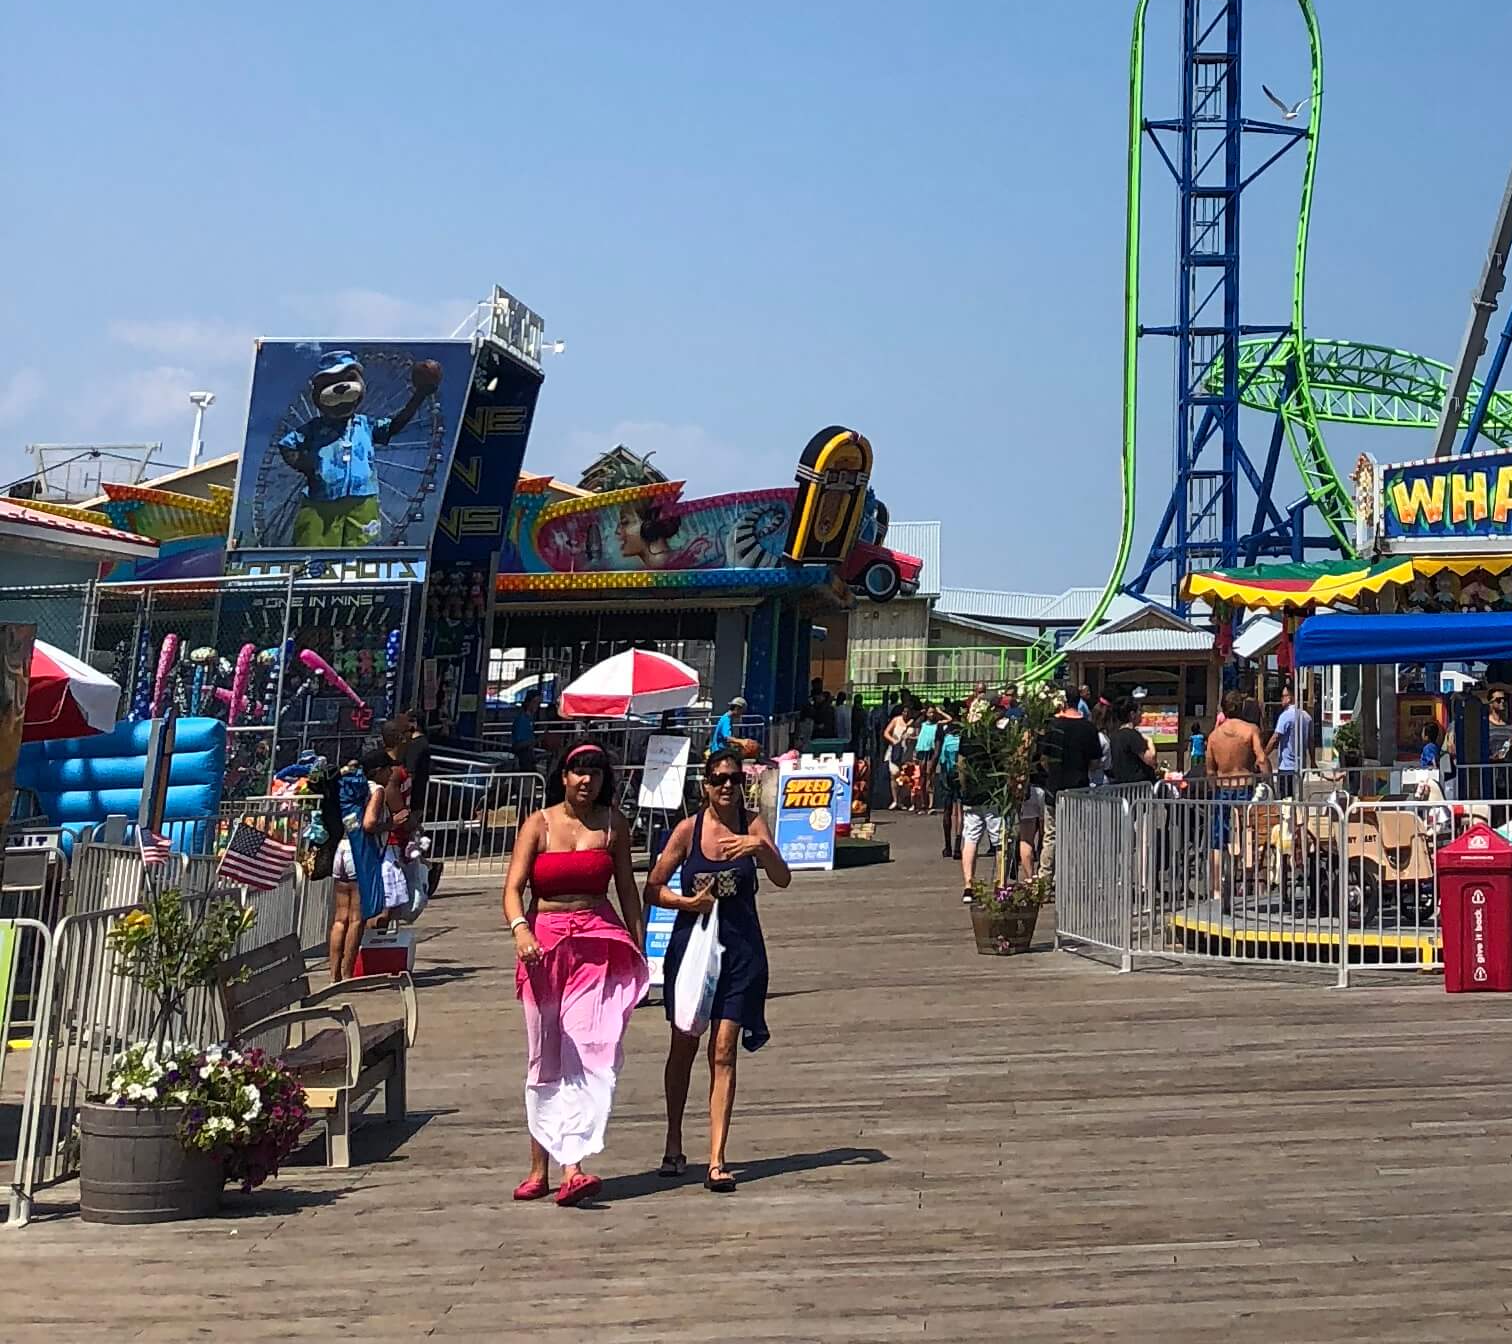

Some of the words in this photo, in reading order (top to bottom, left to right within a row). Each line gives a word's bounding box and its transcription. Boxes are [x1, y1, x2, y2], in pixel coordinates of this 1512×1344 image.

[785, 779, 833, 793] SPEED
[783, 792, 831, 808] PITCH
[1473, 907, 1483, 932] back
[1474, 933, 1483, 941] it
[1475, 942, 1487, 964] give
